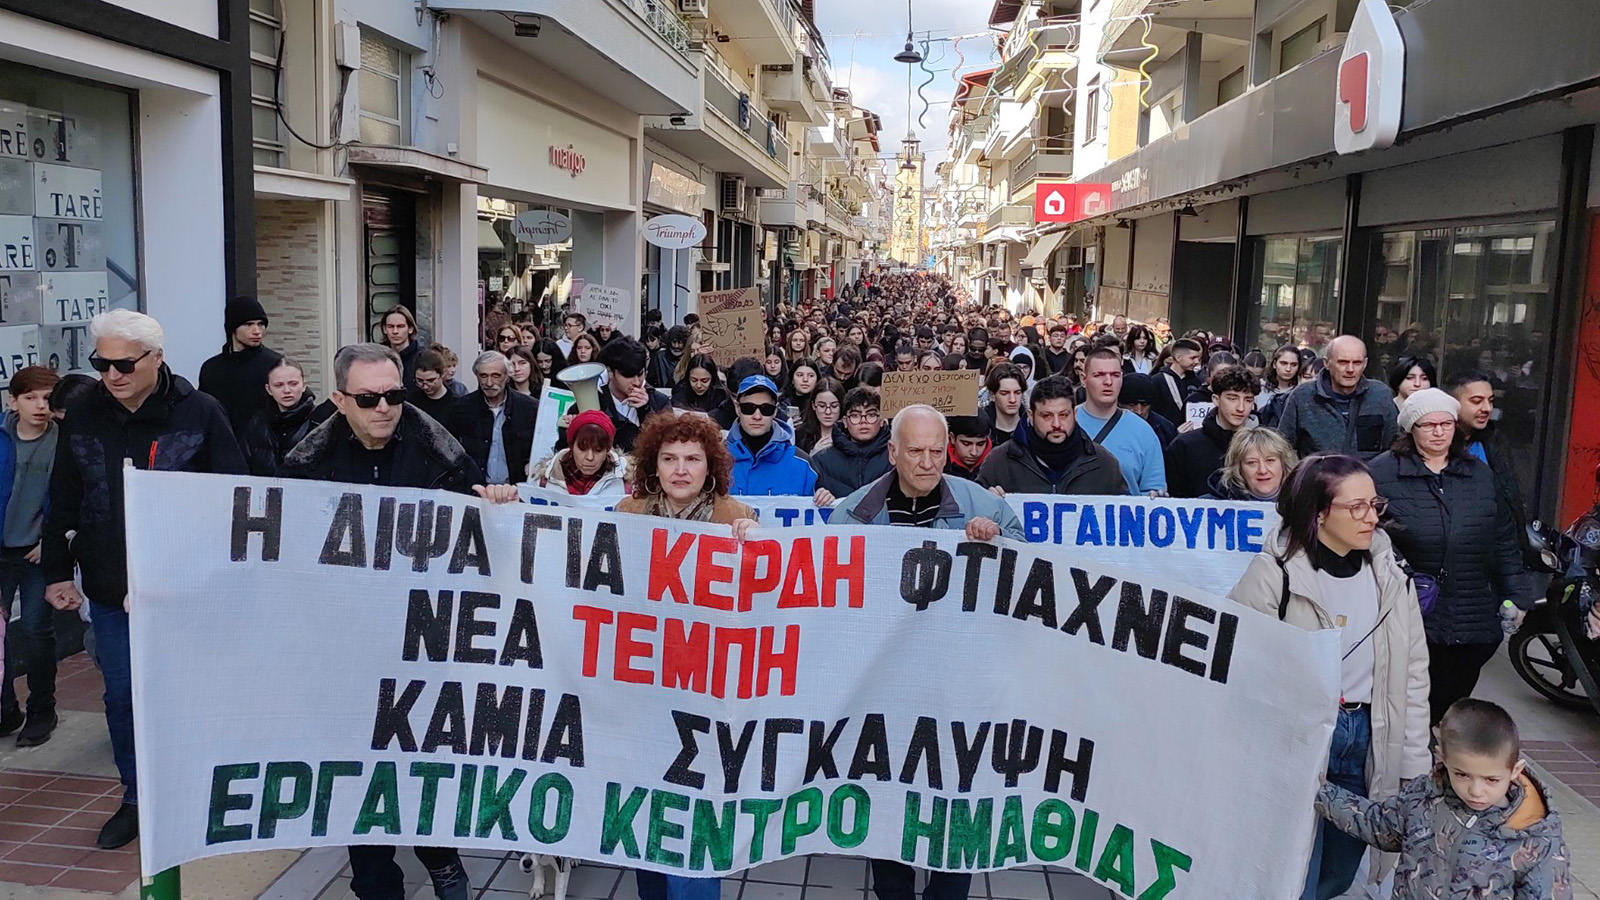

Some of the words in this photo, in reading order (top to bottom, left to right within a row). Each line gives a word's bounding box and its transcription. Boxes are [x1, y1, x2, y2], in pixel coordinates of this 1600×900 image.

[647, 223, 697, 244] Triumph
[883, 373, 905, 384] ΔΕΝ
[908, 374, 930, 384] ΕΧΩ
[884, 385, 899, 397] 57
[931, 394, 954, 407] 28/2
[1023, 502, 1264, 553] ΒΓΑΙΝΟΥΜΕ
[230, 486, 283, 562] Η
[318, 492, 492, 576] ΔΙΨΑ
[520, 513, 625, 596] ΓΙΑ
[648, 528, 866, 612] ΚΕΡΔΗ
[900, 540, 1239, 684] ΦΤΙΑΧΝΕΙ
[402, 589, 544, 669] ΝΕΑ
[572, 604, 800, 699] ΤΕΜΠΗ
[371, 678, 585, 768] ΚΑΜΙΑ
[662, 710, 1095, 803] ΣΥΓΚΑΛΥΨΗ
[206, 761, 574, 846] ΕΡΓΑΤΙΚΟ
[600, 781, 871, 871] ΚΕΝΤΡΟ
[900, 790, 1193, 900] ΗΜΑΘΙΑΣ
